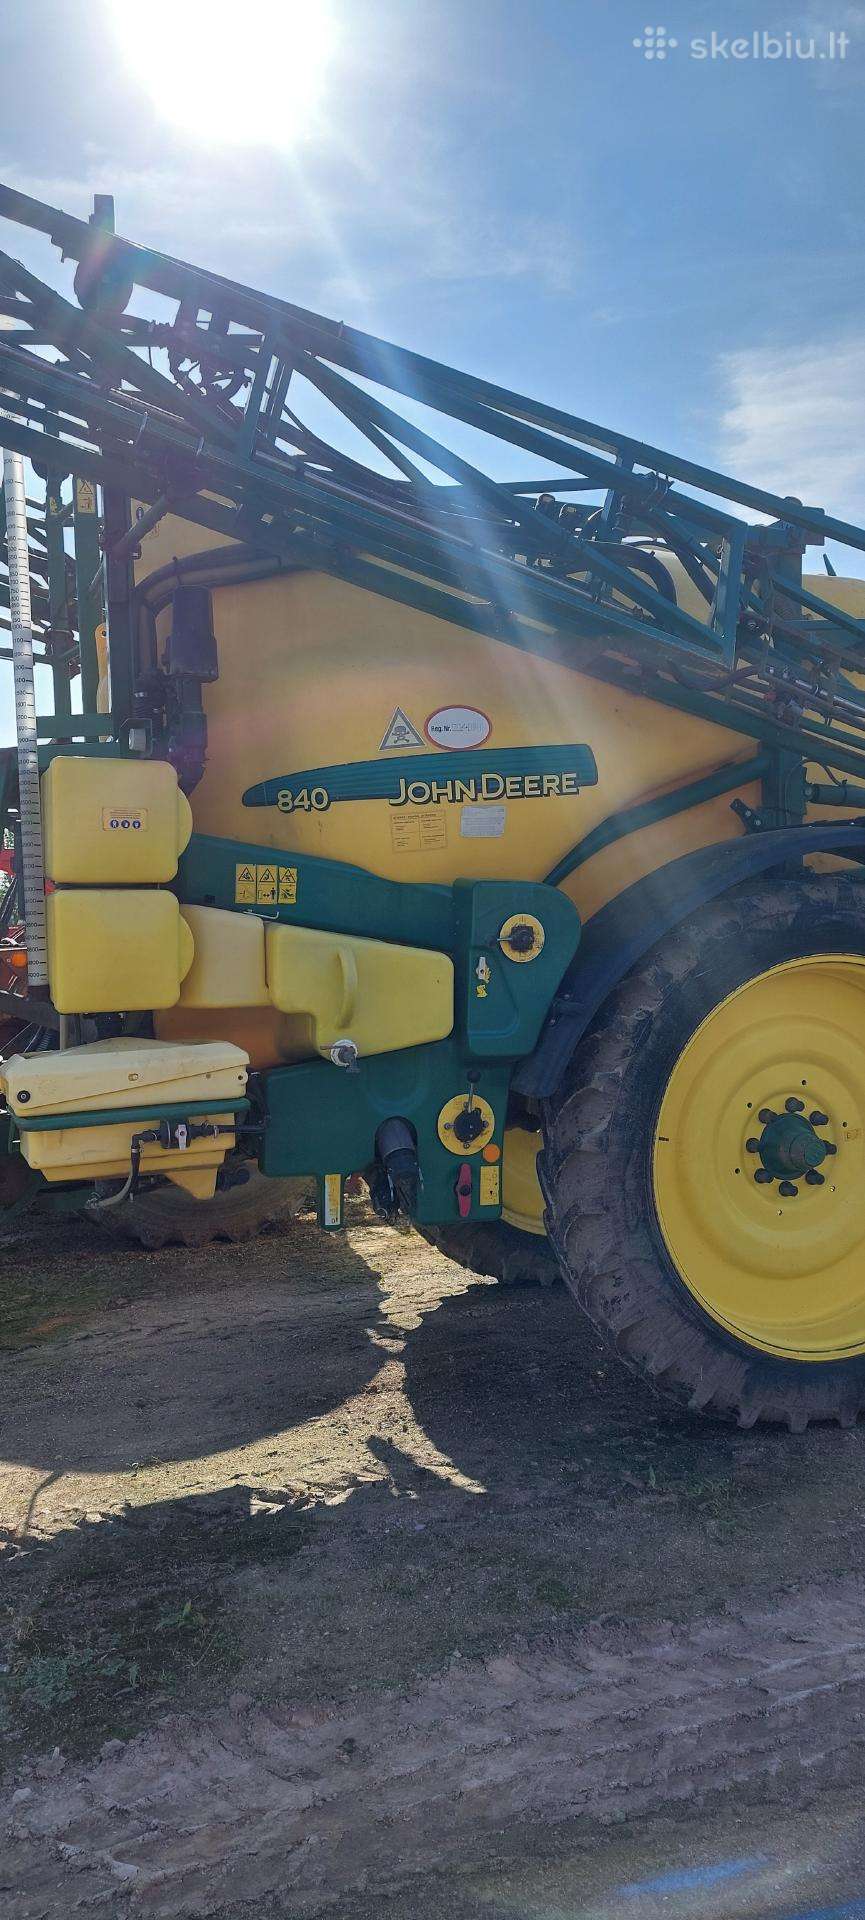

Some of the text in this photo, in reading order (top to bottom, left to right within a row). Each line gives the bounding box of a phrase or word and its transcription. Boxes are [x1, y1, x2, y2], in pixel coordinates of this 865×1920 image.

[277, 787, 331, 813] 840
[389, 772, 580, 807] JOHN DEERE
